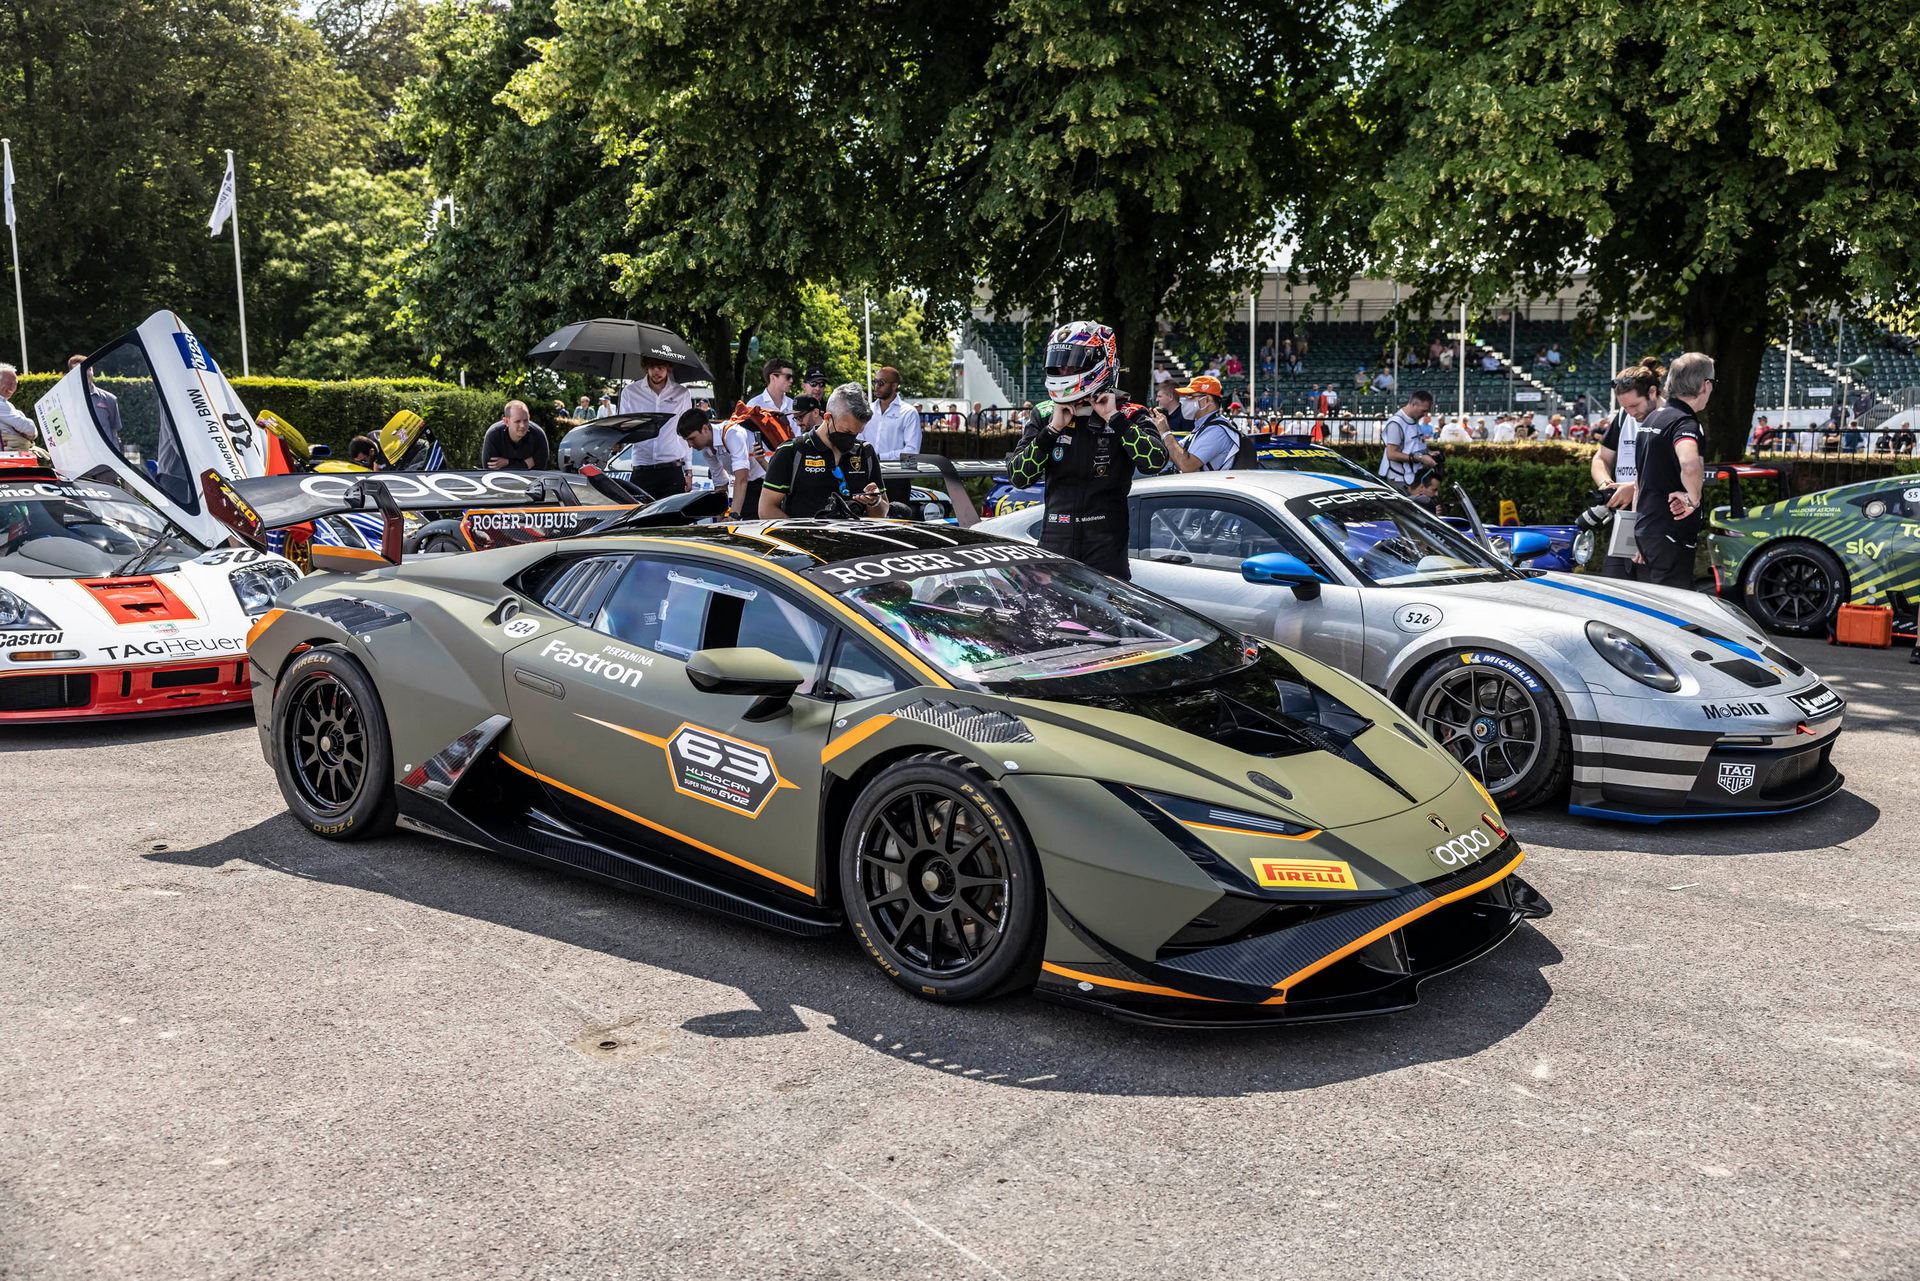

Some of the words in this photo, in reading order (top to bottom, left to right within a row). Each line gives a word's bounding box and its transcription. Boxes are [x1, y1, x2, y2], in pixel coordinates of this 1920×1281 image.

[185, 333, 207, 370] 0123
[187, 388, 211, 418] BMW
[206, 419, 219, 435] by
[0, 488, 36, 498] no
[33, 483, 112, 498] Clinic
[473, 514, 520, 530] ROGER
[524, 512, 578, 529] DUBUIS
[203, 550, 261, 566] 30
[1846, 538, 1885, 559] sky
[823, 553, 966, 584] ROGER
[508, 621, 535, 635] 524
[1406, 612, 1431, 625] 526
[0, 632, 64, 648] Castrol
[291, 655, 331, 675] PIRELLI
[540, 639, 643, 688] Fastron
[602, 645, 654, 667] PERTAMINA
[1482, 655, 1538, 689] MICHELIN
[1701, 703, 1752, 720] Mobil
[676, 732, 771, 785] 63
[1722, 765, 1752, 776] TAG
[684, 778, 699, 787] SUPER
[700, 784, 718, 795] TROFEO
[718, 789, 750, 806] EVO2
[1720, 777, 1751, 792] HEUER
[347, 815, 354, 827] P
[960, 783, 973, 794] P
[971, 793, 1011, 842] ZERO
[313, 823, 347, 834] ZERO
[1436, 829, 1490, 866] oppo
[1262, 863, 1346, 884] PIRELLI
[855, 922, 899, 977] PIRELLI
